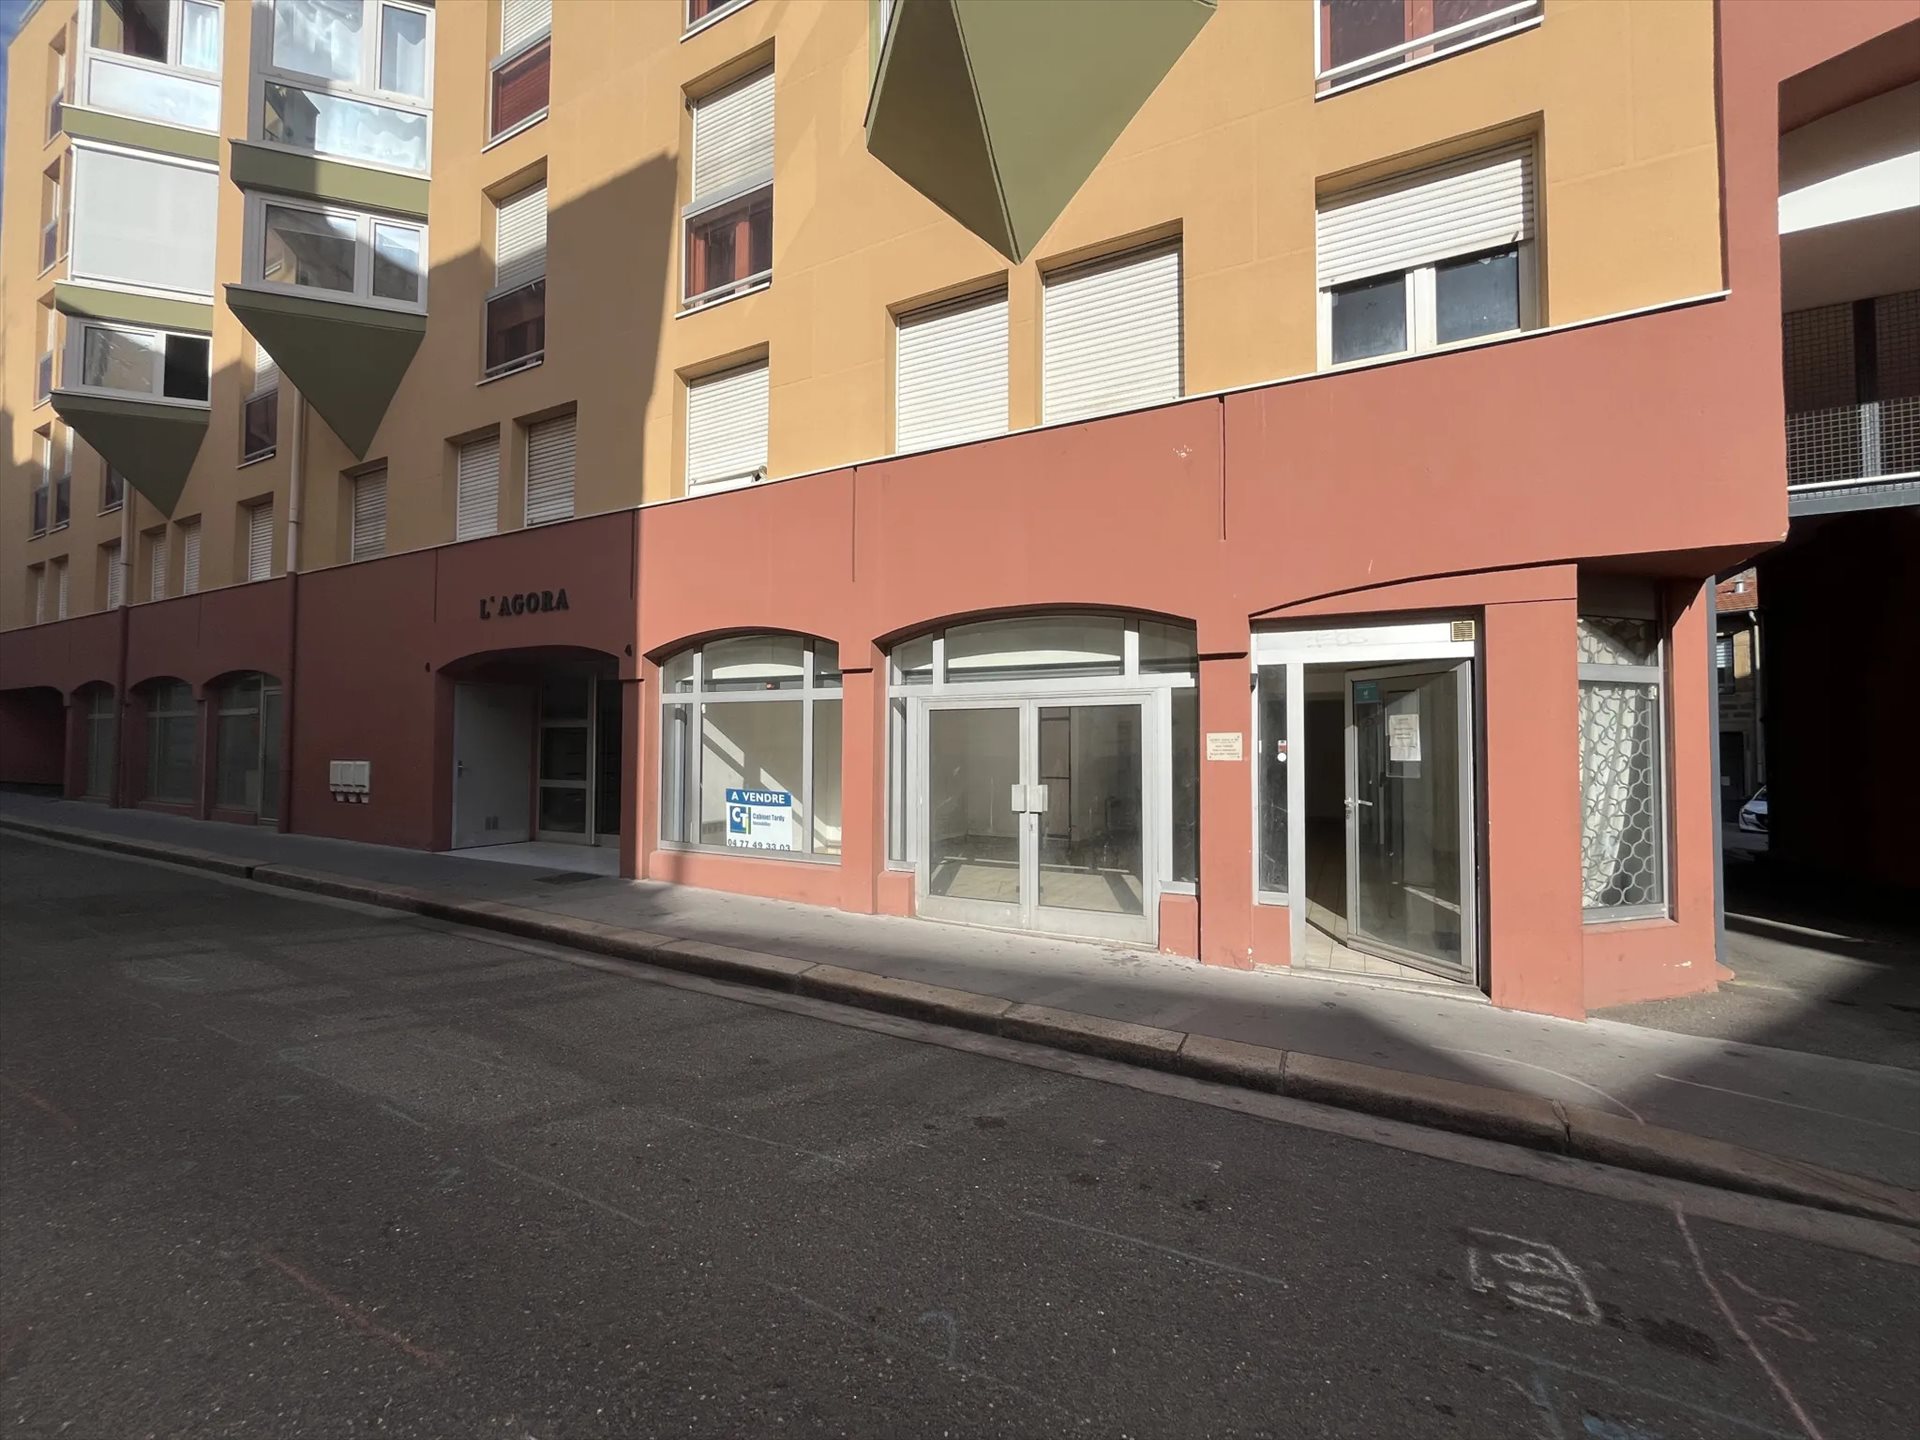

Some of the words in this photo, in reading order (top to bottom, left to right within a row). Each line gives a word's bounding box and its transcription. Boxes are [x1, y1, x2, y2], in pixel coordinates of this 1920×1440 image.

[480, 588, 569, 620] L'AGORA
[731, 791, 739, 801] A
[742, 792, 785, 804] VENDRE
[740, 839, 749, 849] 77
